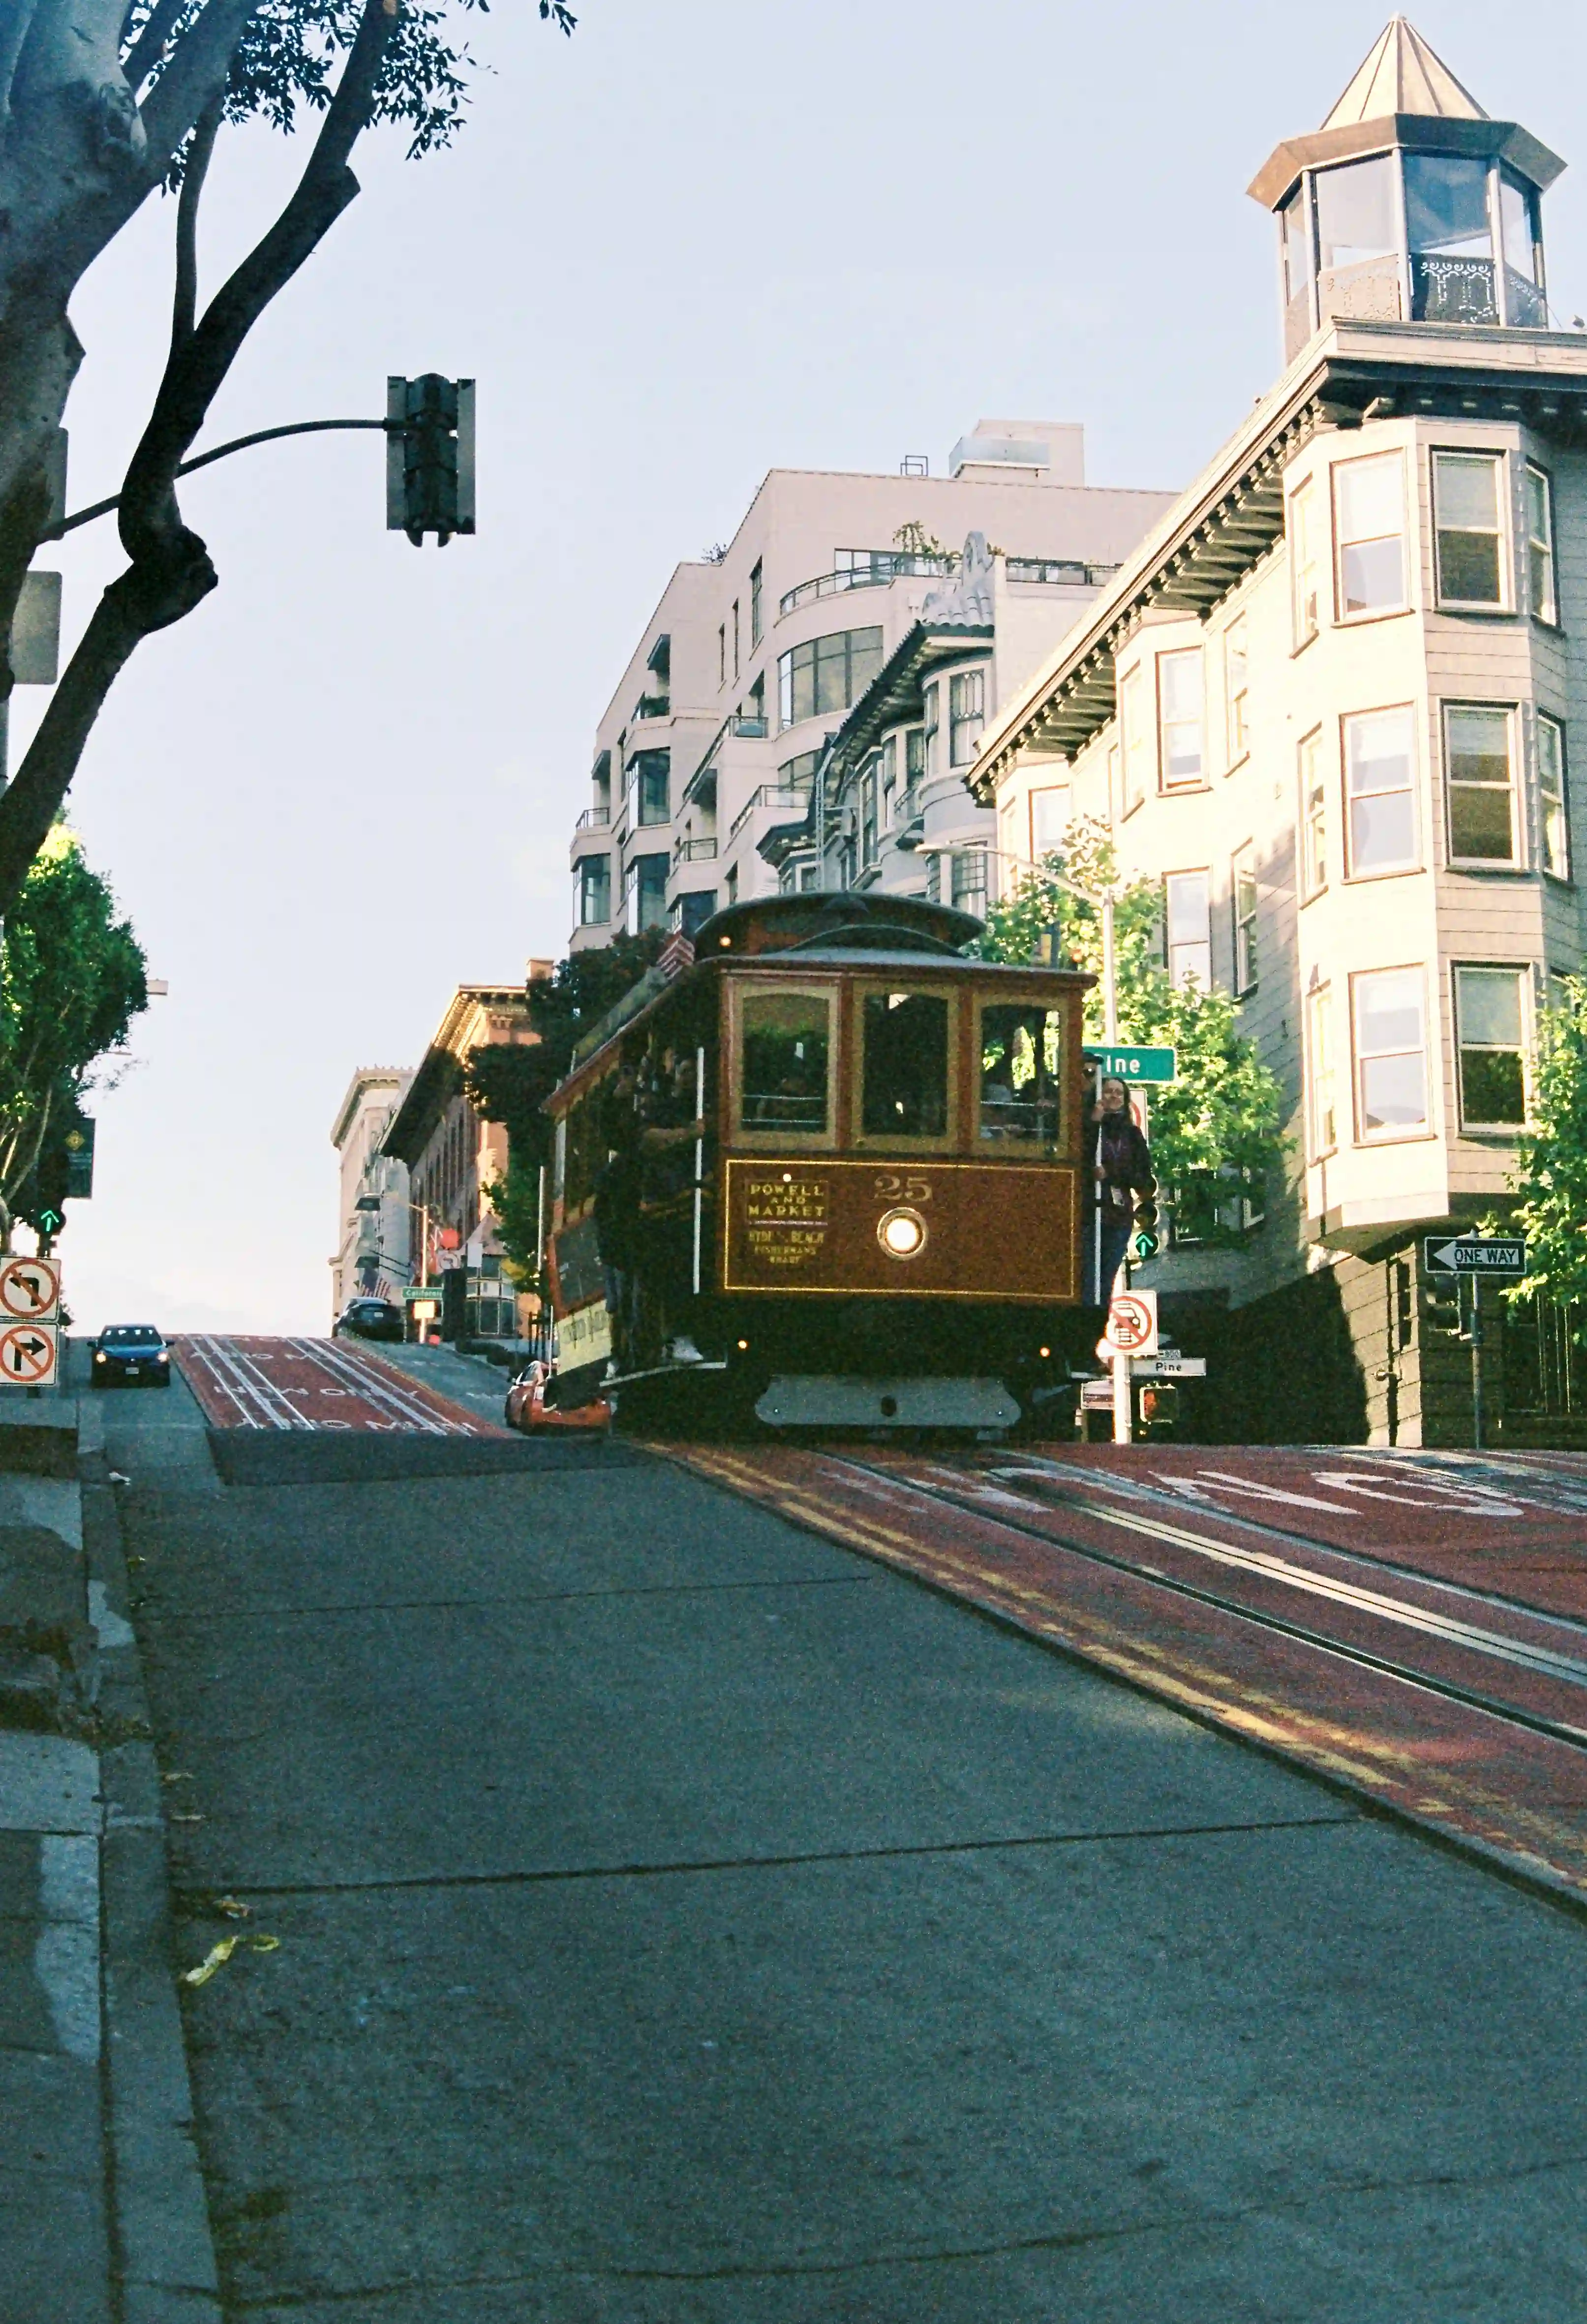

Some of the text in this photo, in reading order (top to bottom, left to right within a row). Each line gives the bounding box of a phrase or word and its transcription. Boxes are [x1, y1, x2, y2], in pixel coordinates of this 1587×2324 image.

[750, 1184, 824, 1196] POWELL
[873, 1174, 933, 1202] 25
[770, 1196, 806, 1205] AND
[748, 1205, 824, 1216] MARKET
[1454, 1248, 1516, 1264] ONE WAY
[1156, 1362, 1182, 1371] Pine
